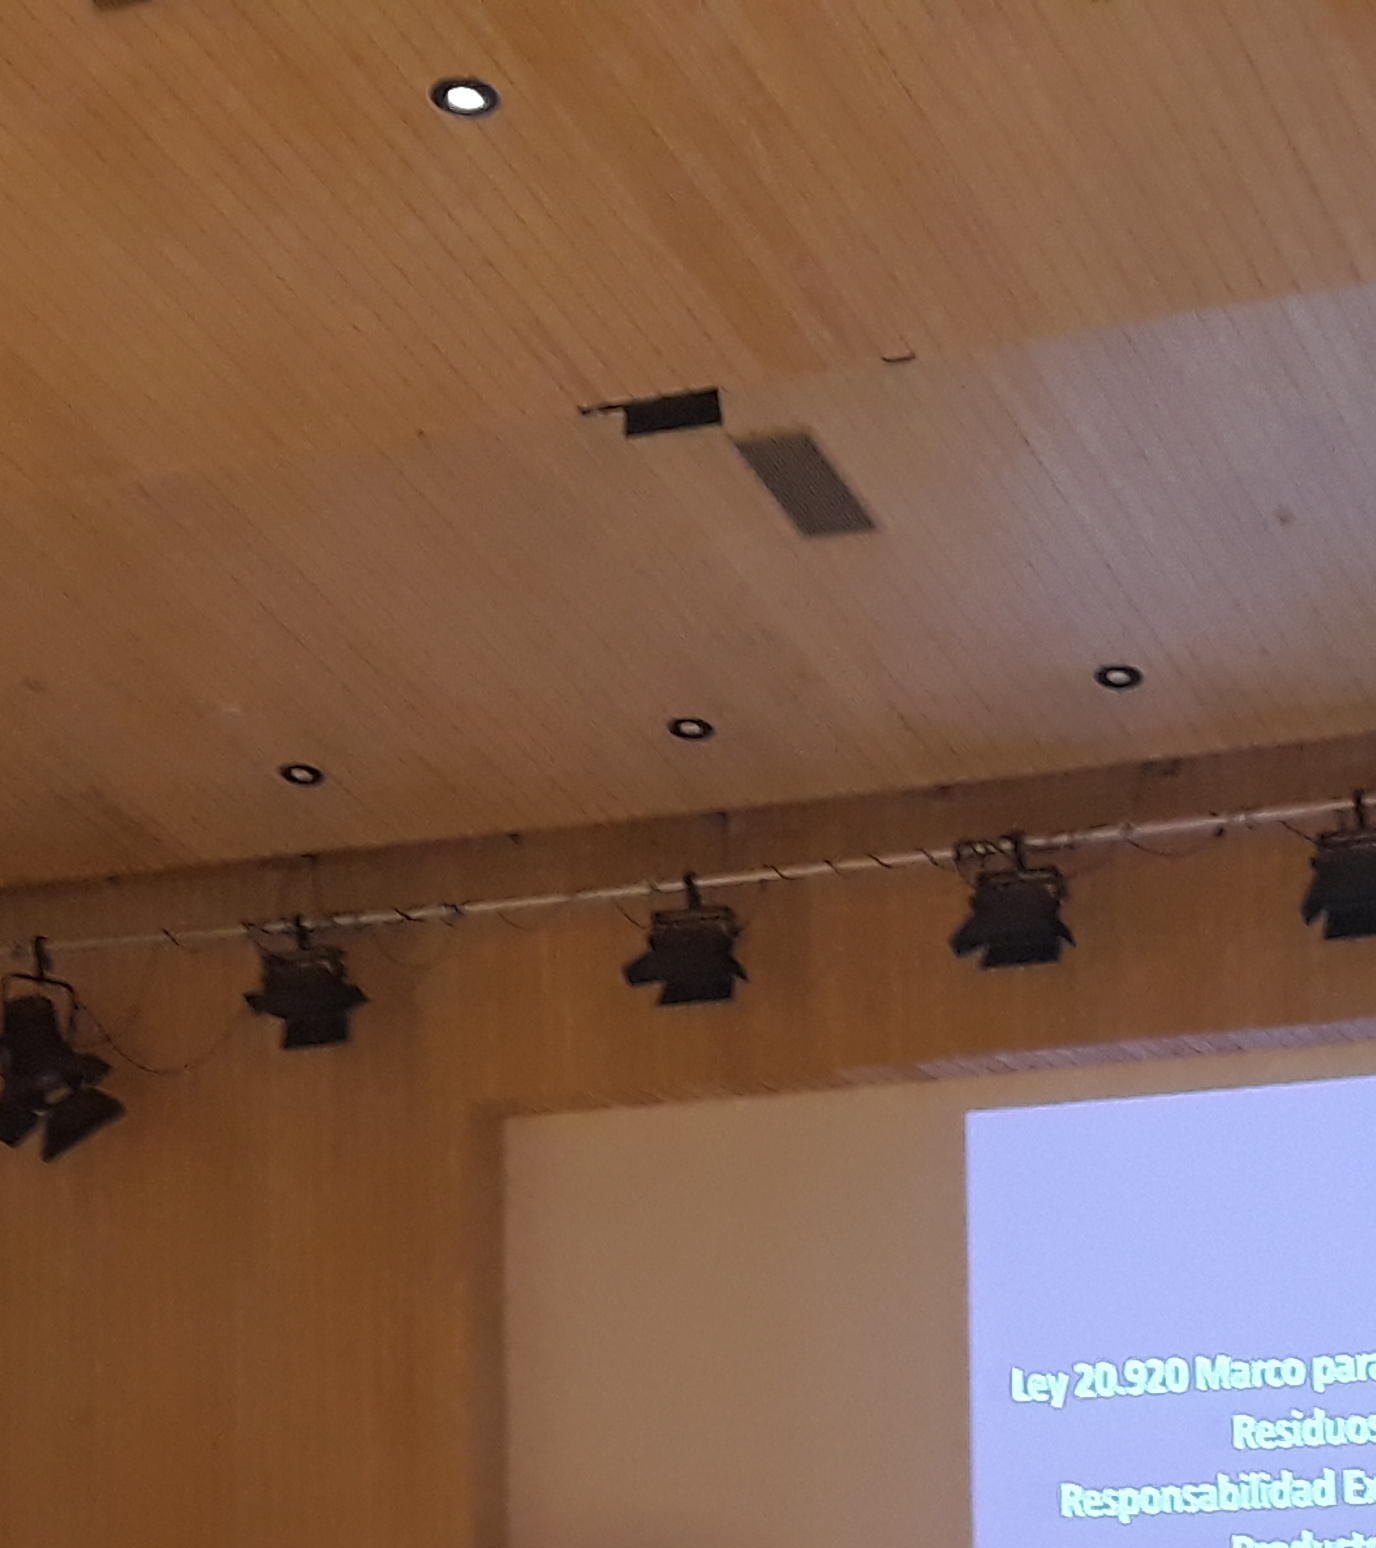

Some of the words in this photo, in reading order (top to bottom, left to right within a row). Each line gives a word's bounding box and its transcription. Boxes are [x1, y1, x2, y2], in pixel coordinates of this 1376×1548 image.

[1011, 1367, 1068, 1408] Ley
[1073, 1357, 1189, 1398] 20.920
[1195, 1353, 1306, 1392] Marco
[1060, 1467, 1337, 1524] Responsabilidad
